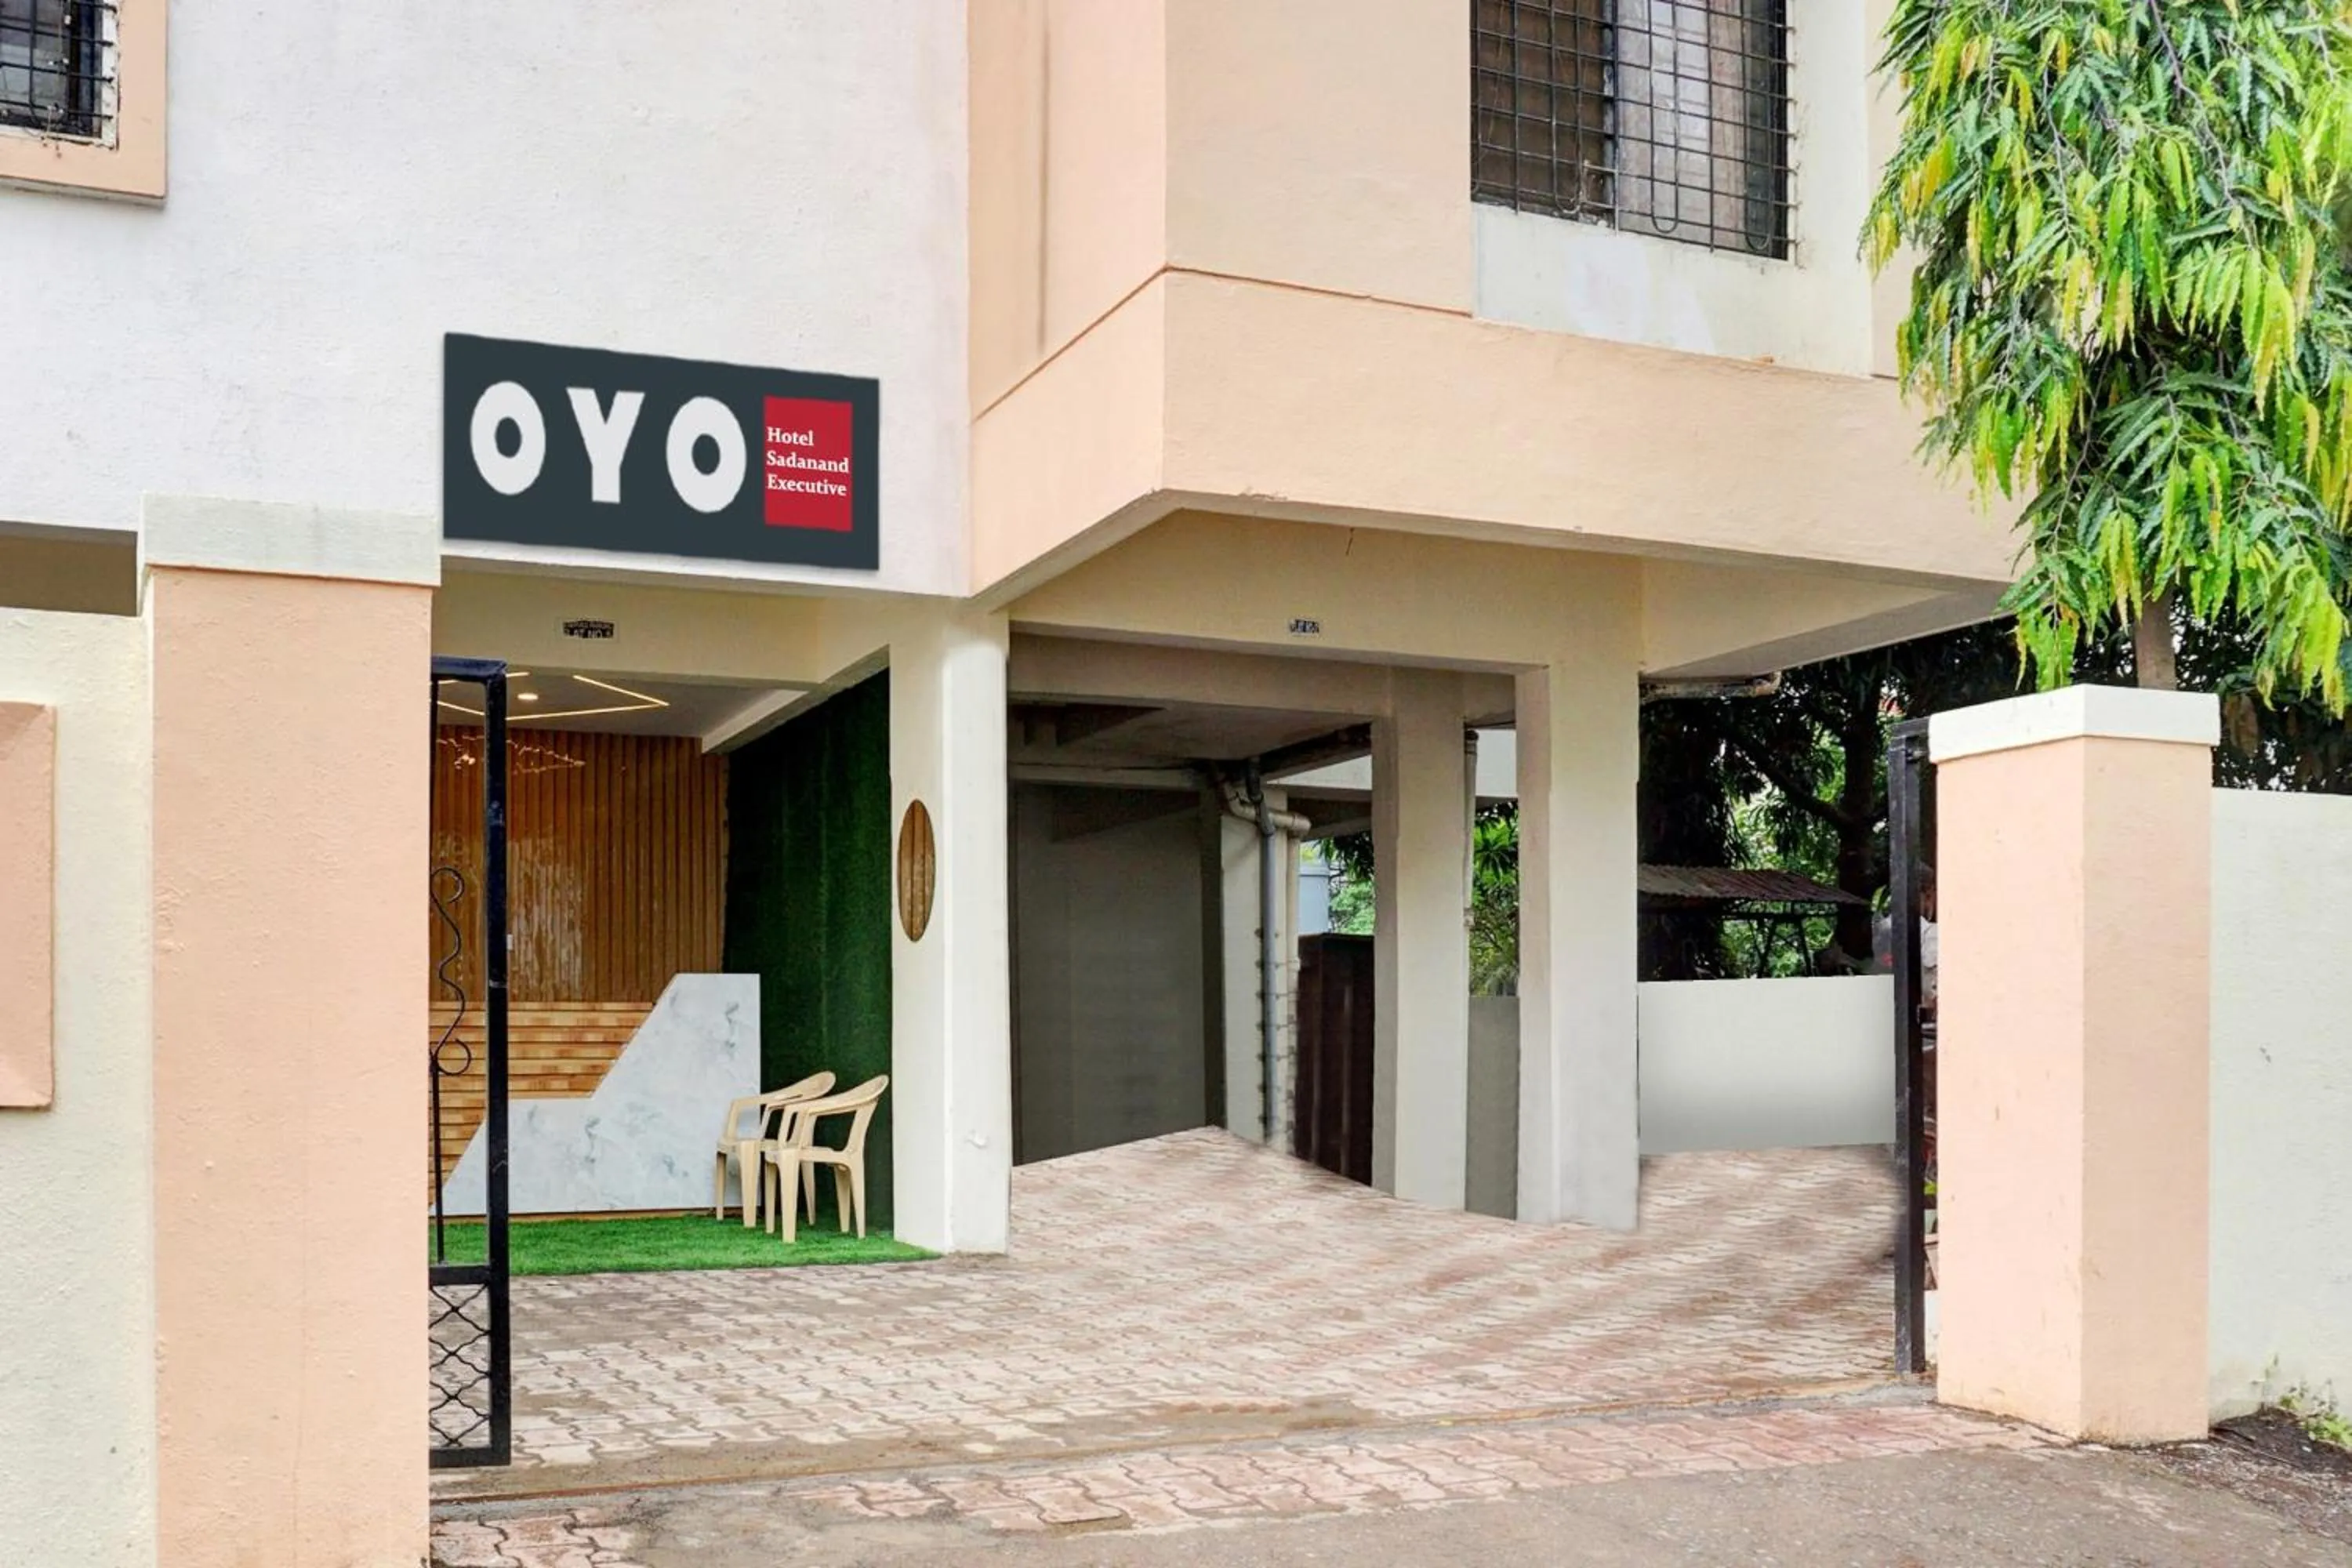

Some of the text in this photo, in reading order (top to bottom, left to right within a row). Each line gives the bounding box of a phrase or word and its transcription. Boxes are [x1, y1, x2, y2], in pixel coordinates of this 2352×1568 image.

[470, 381, 747, 513] OYO
[767, 426, 815, 446] Hotel
[766, 449, 849, 474] Sadanand
[767, 474, 848, 496] Executive
